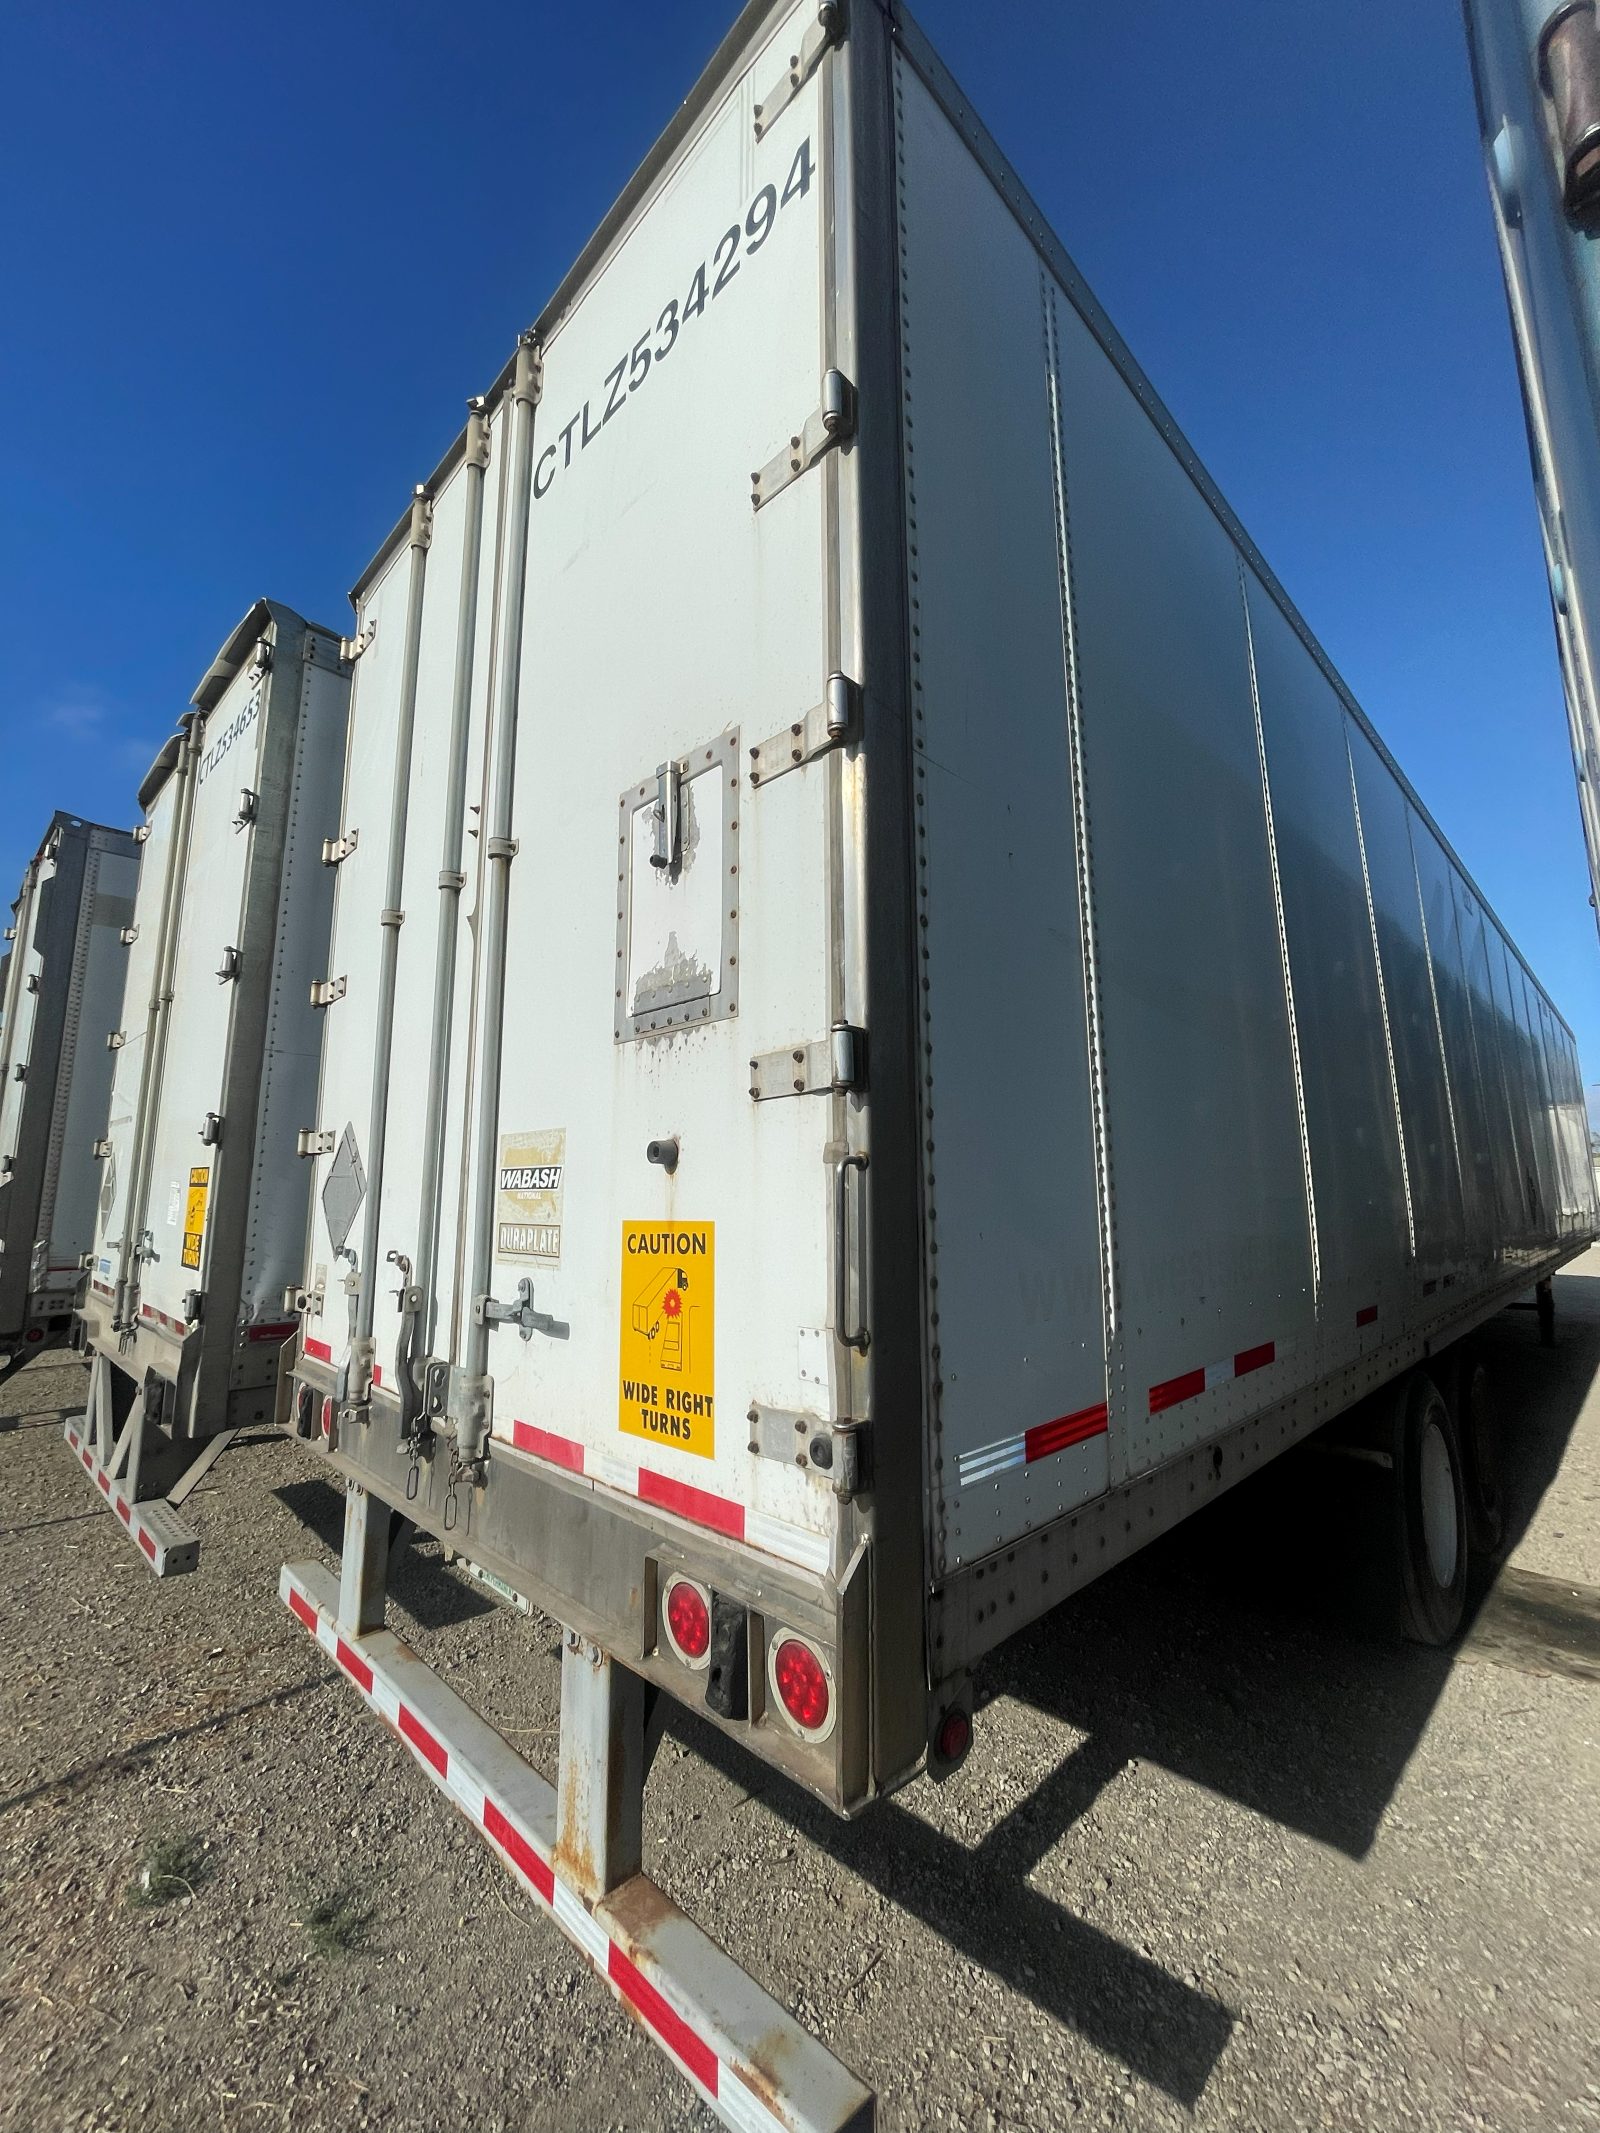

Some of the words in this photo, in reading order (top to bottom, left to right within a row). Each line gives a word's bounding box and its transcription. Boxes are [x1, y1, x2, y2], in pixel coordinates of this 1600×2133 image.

[533, 135, 816, 500] CTLZ534294
[501, 1168, 560, 1189] WABASH
[500, 1226, 560, 1253] DURAPLATE
[627, 1233, 707, 1255] CAUTION
[623, 1380, 658, 1406] WIDE
[666, 1388, 713, 1418] RIGHT
[641, 1408, 691, 1440] TURNS
